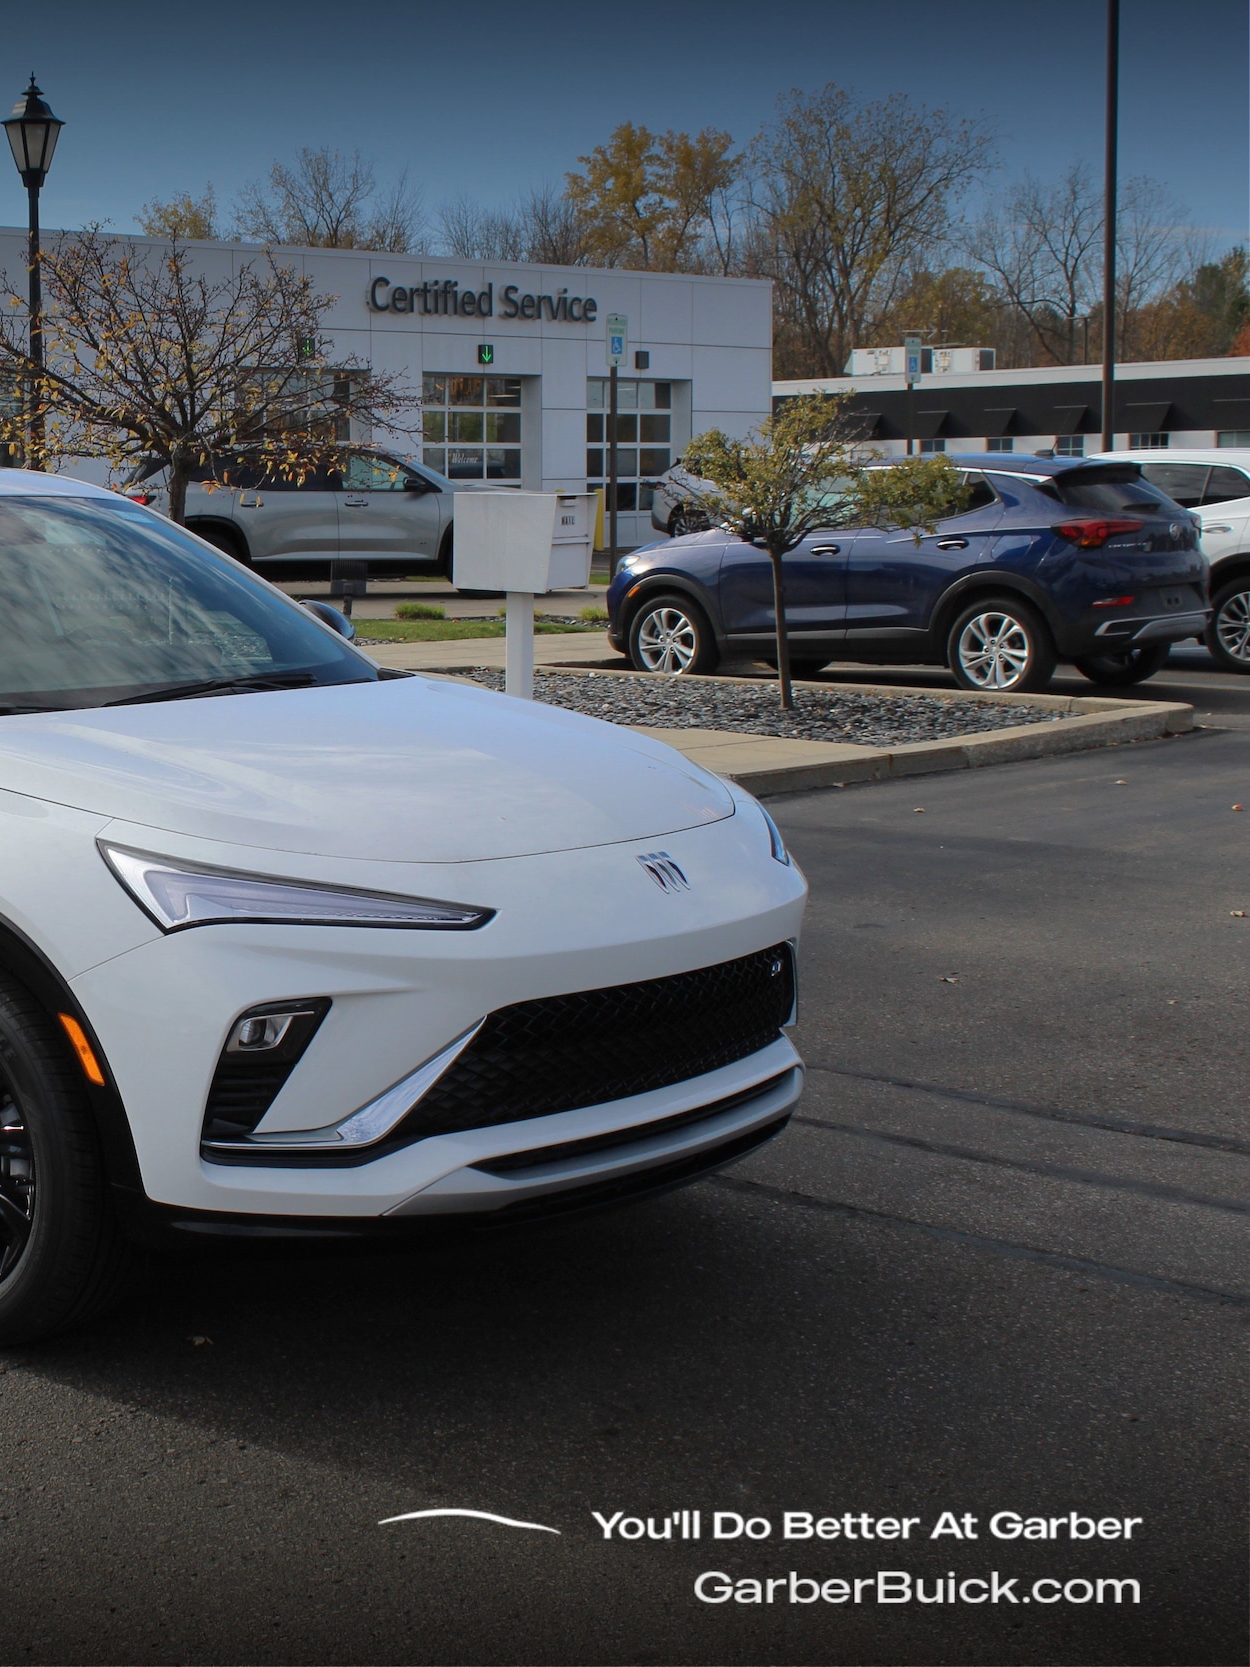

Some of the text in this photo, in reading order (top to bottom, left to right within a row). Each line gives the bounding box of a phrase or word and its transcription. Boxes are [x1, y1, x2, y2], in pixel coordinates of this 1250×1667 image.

[367, 276, 598, 322] Certified Service
[451, 453, 479, 464] Welcome
[561, 516, 575, 525] MAIL
